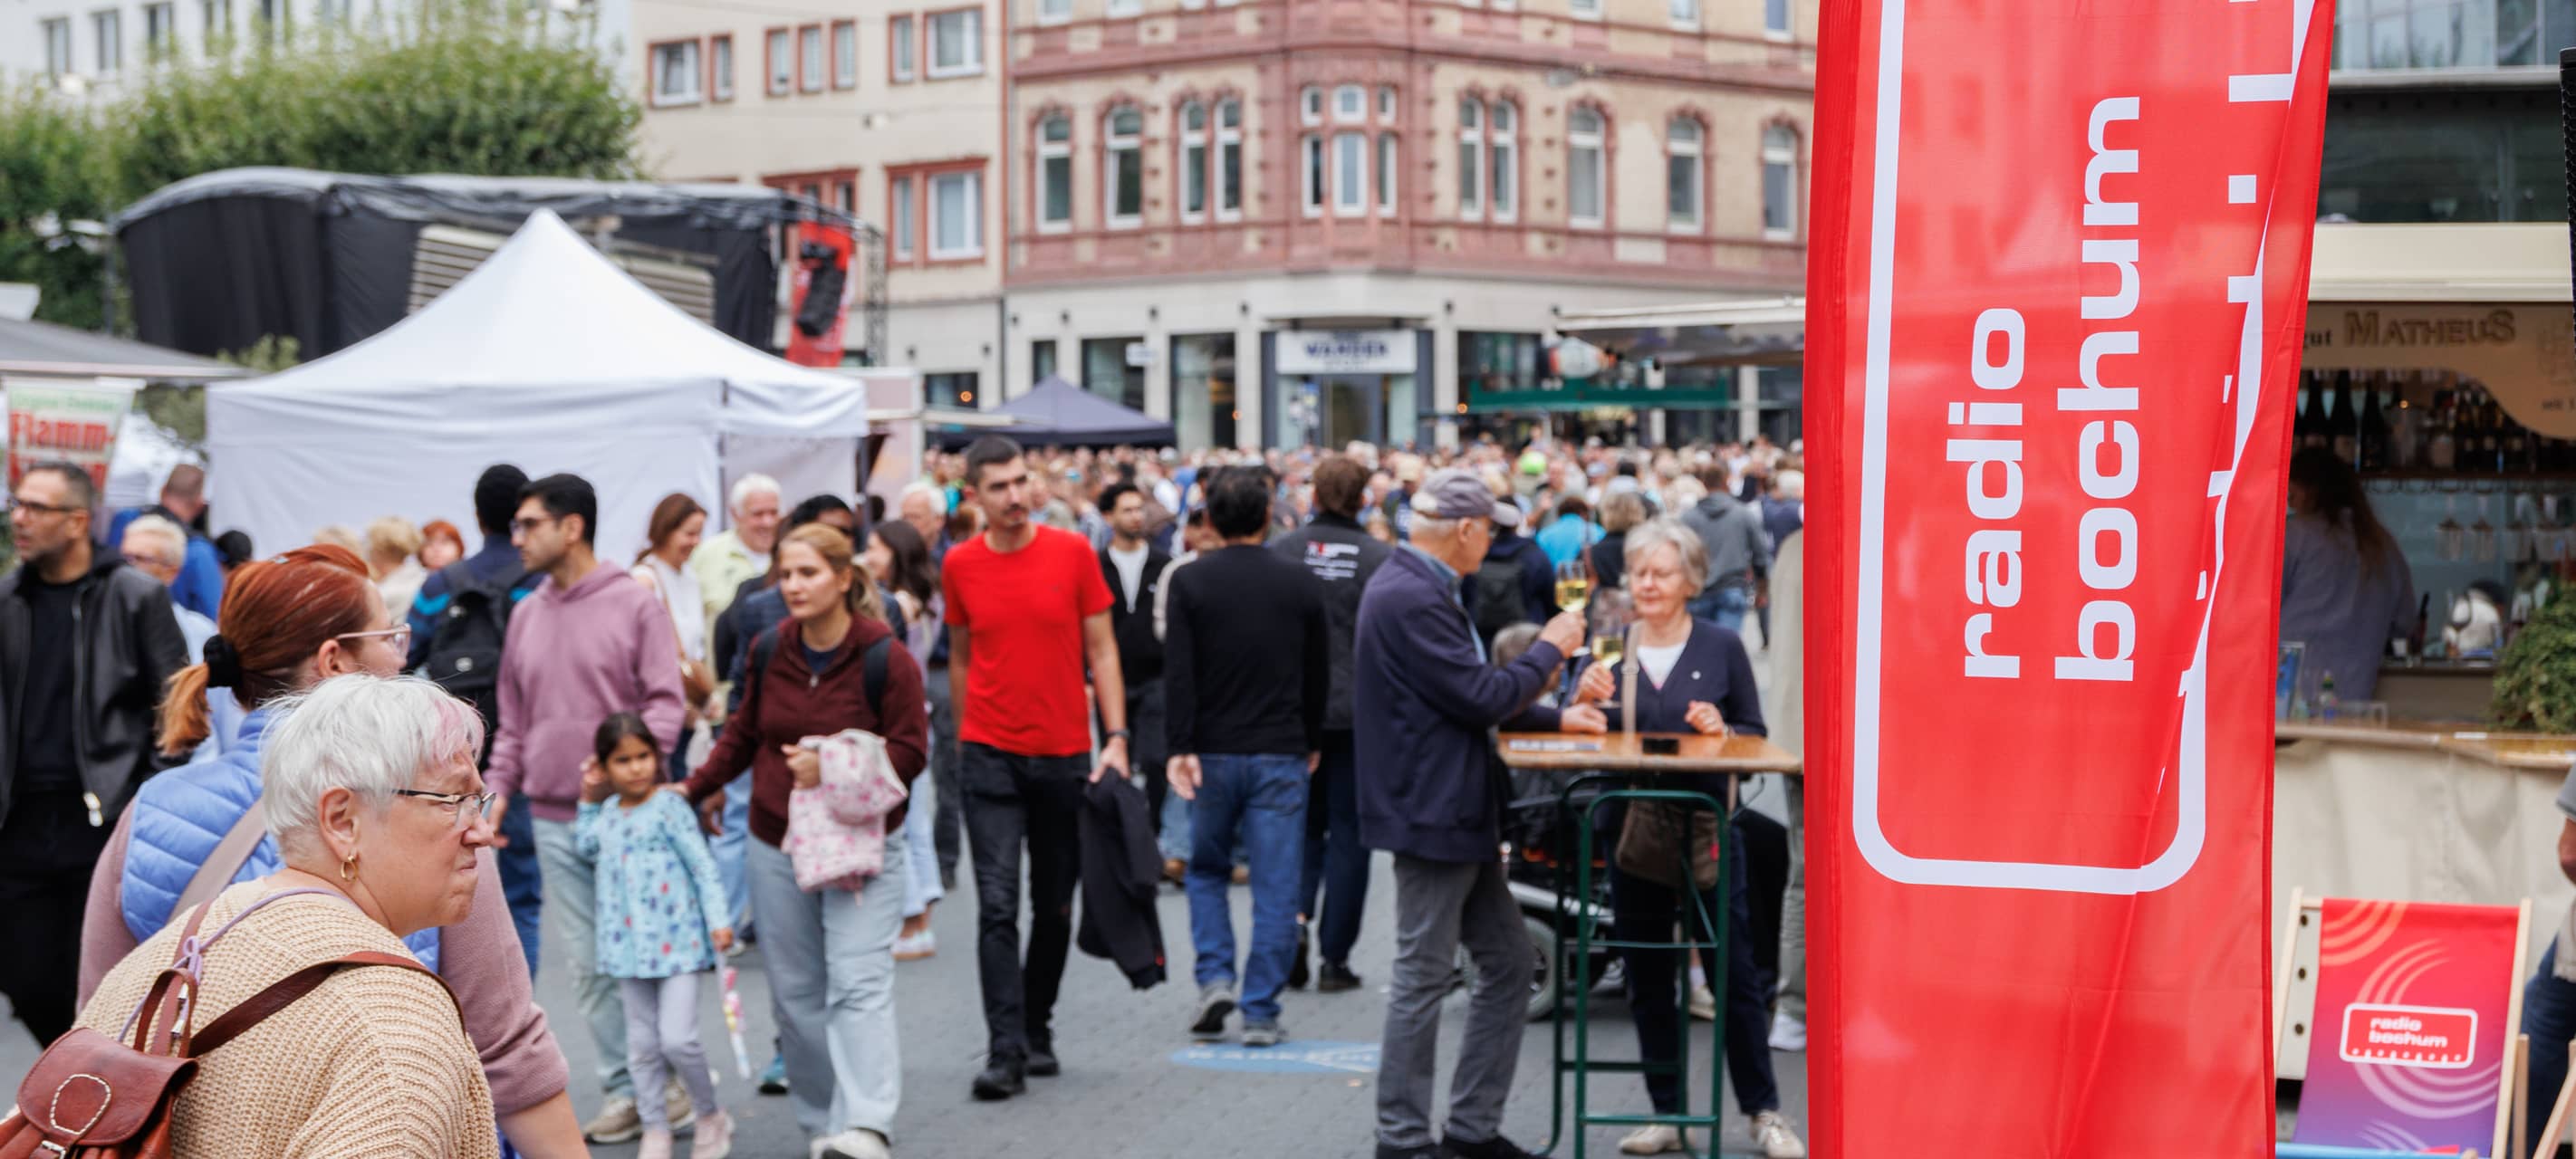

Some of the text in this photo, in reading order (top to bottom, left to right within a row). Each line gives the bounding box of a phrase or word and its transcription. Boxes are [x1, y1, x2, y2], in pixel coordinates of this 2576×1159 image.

[2054, 96, 2140, 682] bochum
[1946, 308, 2025, 679] radio
[2369, 1016, 2422, 1031] radio
[2369, 1029, 2448, 1048] bochum
